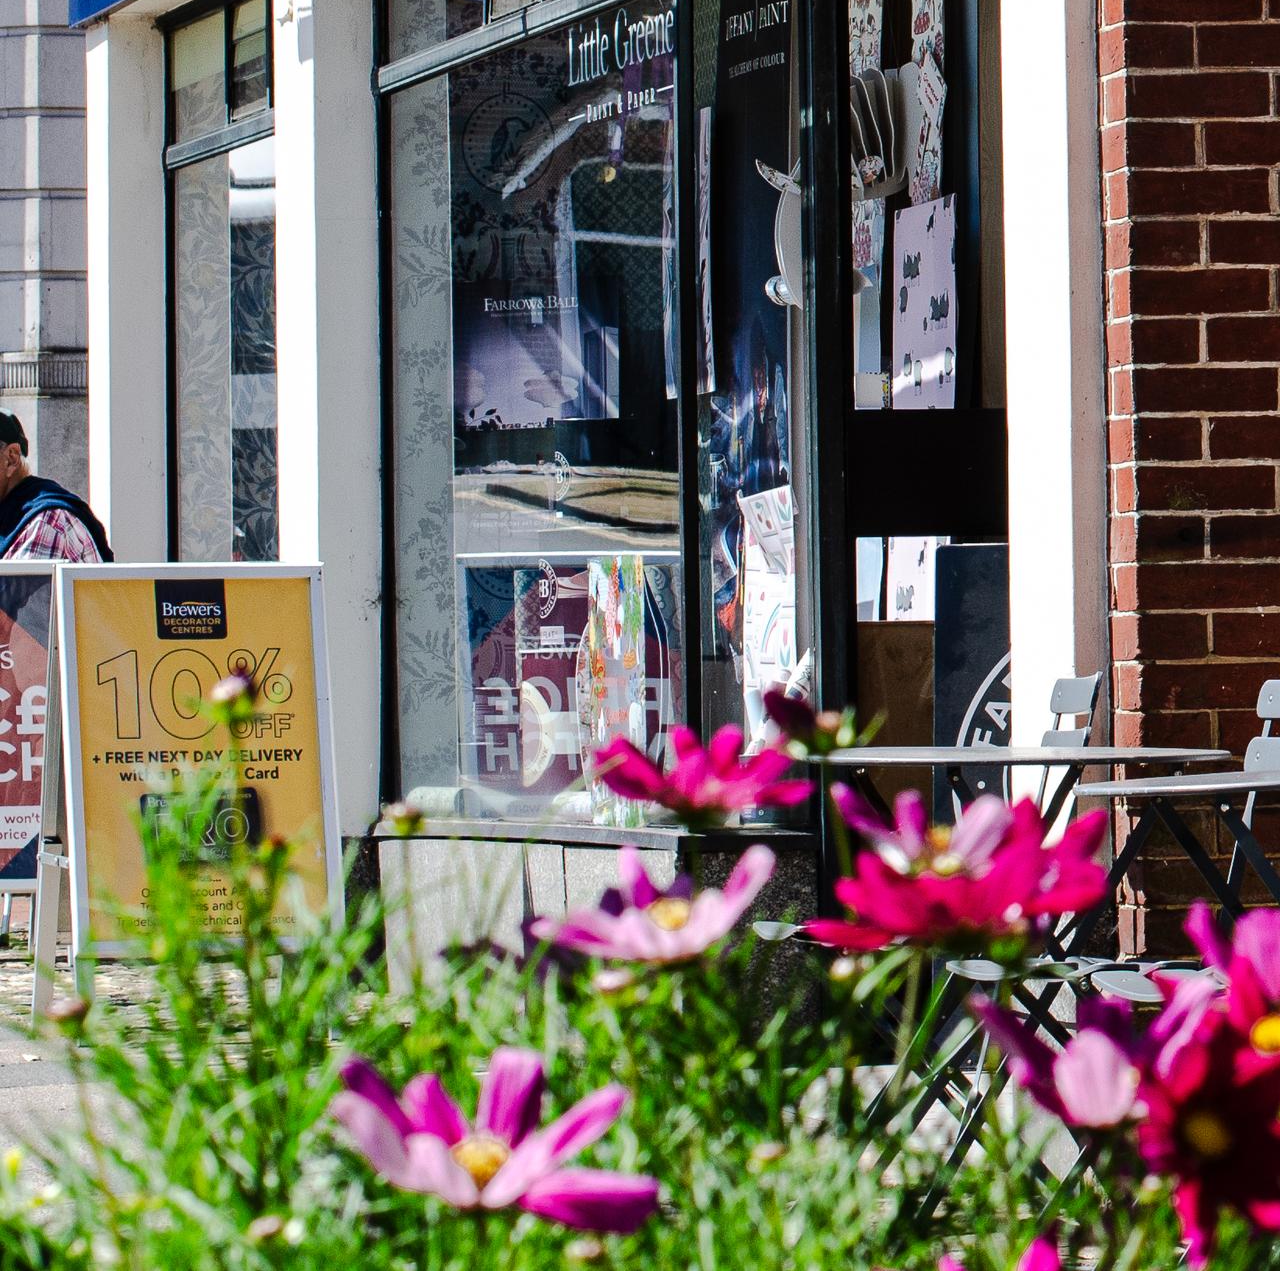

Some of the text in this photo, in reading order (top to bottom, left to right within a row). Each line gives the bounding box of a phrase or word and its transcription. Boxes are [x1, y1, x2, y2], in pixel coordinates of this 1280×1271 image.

[759, 0, 789, 29] PAINT
[568, 8, 674, 88] Little Greene
[760, 51, 785, 68] COLOUR
[587, 88, 656, 123] PAINT & PAPER
[484, 297, 537, 312] FARROW
[547, 295, 579, 309] BALL
[162, 602, 221, 617] Brewers
[163, 617, 221, 627] DECORATOR
[171, 626, 213, 635] CENTRES
[97, 647, 294, 741] 10%
[105, 751, 143, 764] FREE
[148, 750, 189, 763] NEXT
[193, 749, 224, 762] DAY
[228, 748, 304, 762] DELIVERY
[244, 766, 279, 780] Card
[4, 812, 41, 824] won't
[212, 901, 234, 912] and
